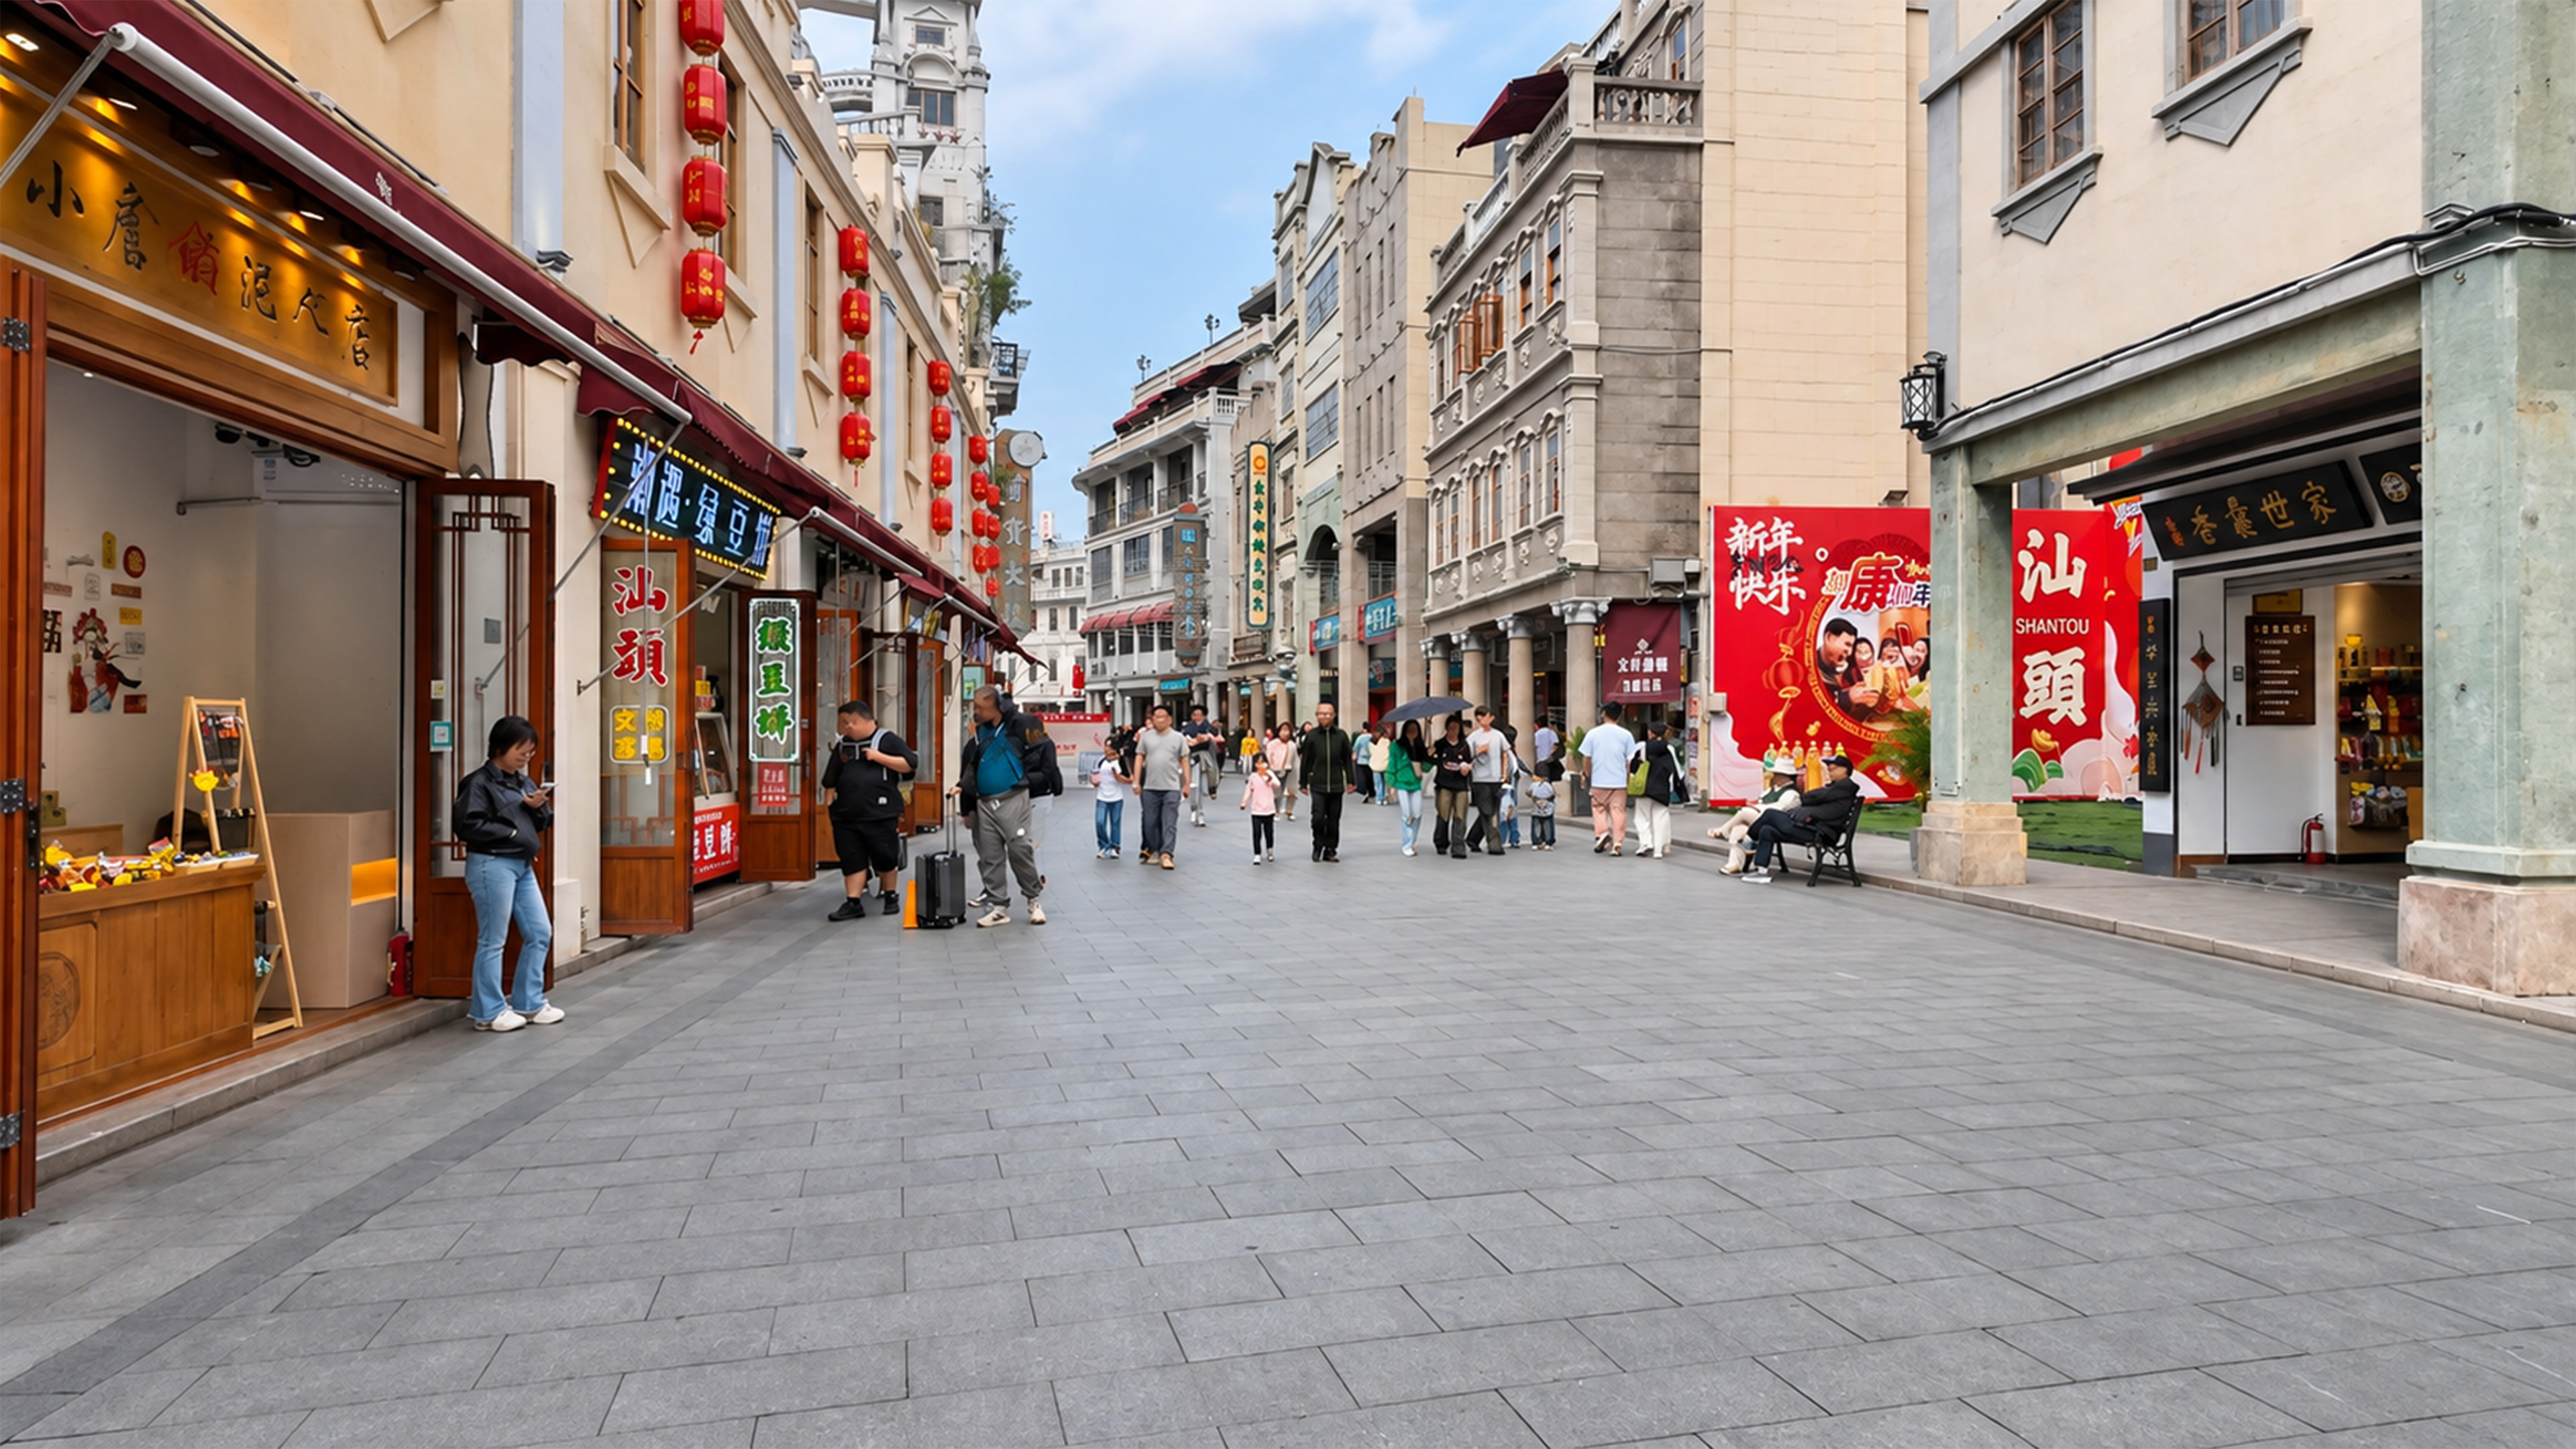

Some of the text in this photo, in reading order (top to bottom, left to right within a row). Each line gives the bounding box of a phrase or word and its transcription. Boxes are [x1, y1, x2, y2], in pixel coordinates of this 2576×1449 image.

[1725, 516, 1804, 562] 新年
[2018, 529, 2087, 602] 汕
[1729, 569, 1807, 616] 快乐
[611, 565, 669, 688] 汕頭
[2015, 618, 2090, 635] SHANTOU
[2019, 646, 2088, 727] 頭
